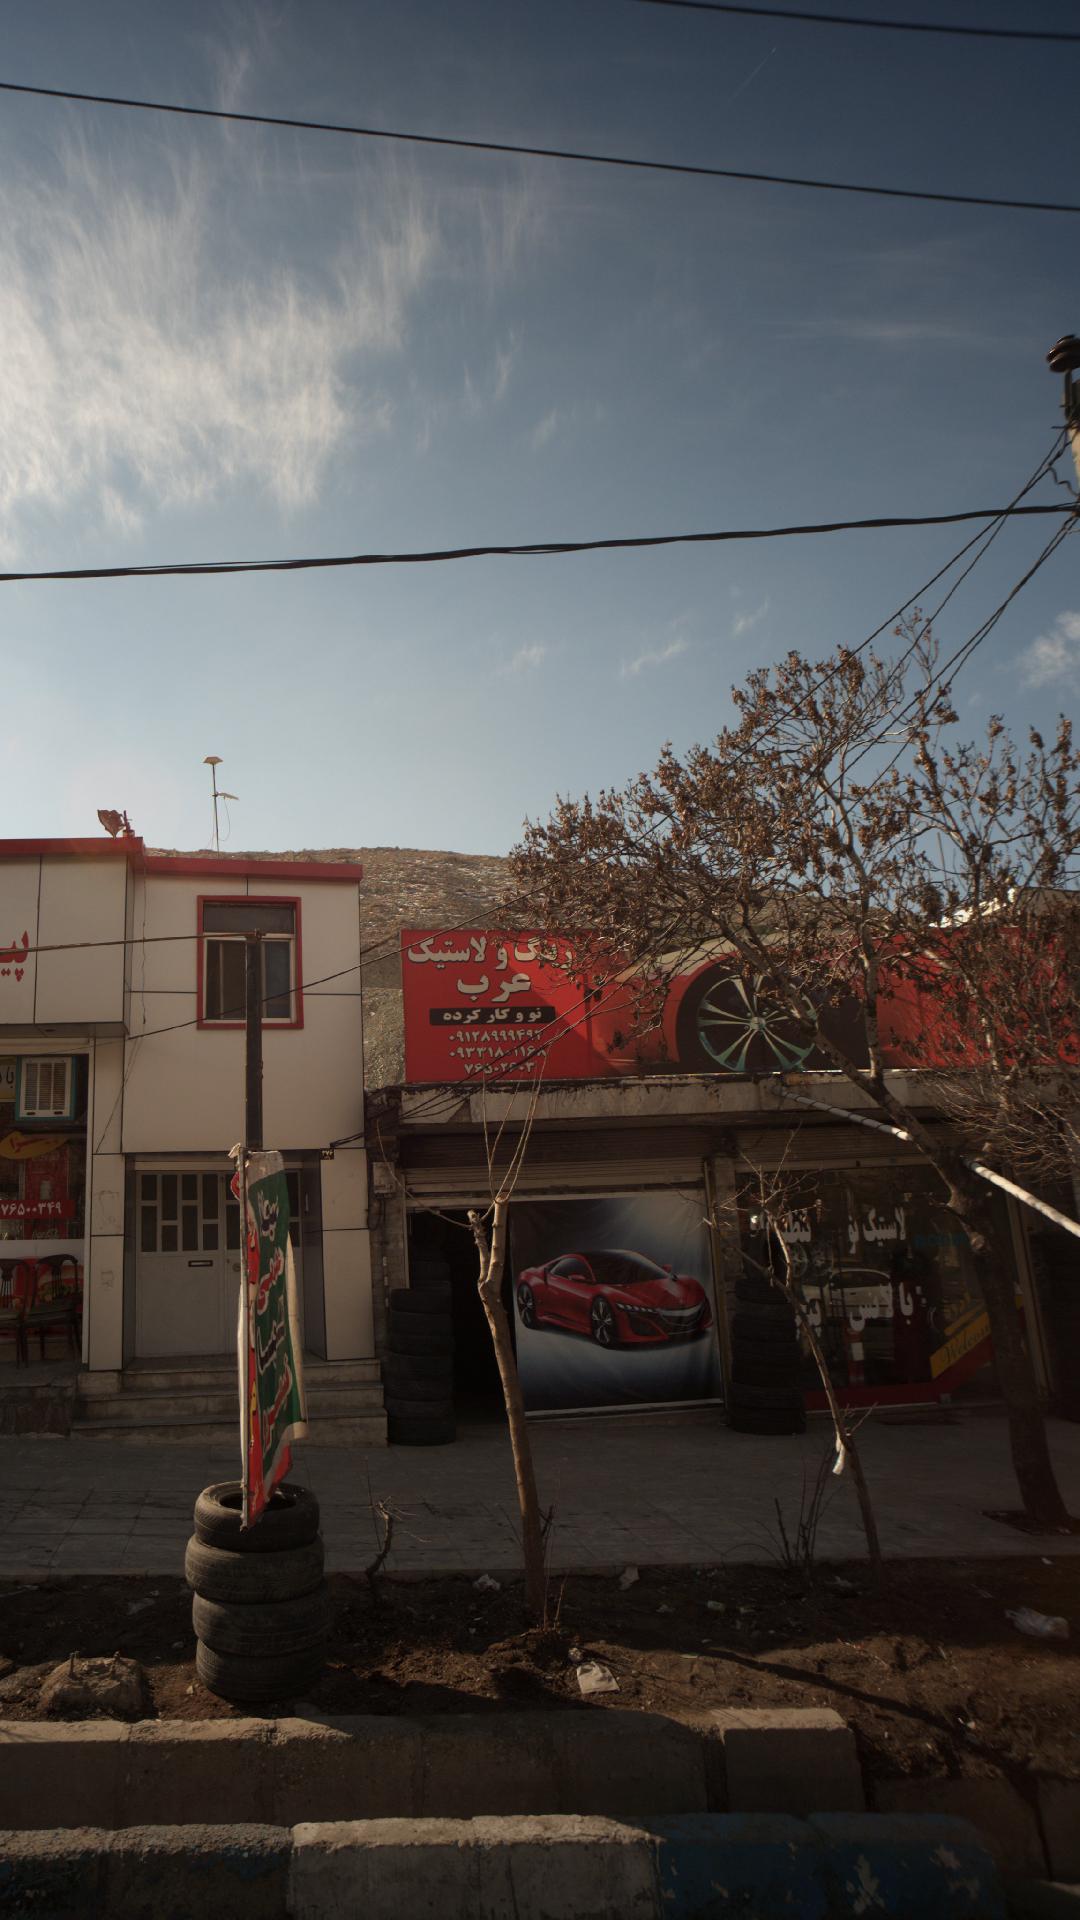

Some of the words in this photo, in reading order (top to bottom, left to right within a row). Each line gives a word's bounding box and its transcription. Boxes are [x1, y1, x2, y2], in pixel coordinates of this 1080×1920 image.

[407, 936, 488, 969] لاستیک
[495, 943, 508, 970] و
[457, 973, 532, 1002] عرب
[443, 1008, 481, 1024] کرده
[486, 1008, 510, 1024] کار
[515, 1010, 524, 1023] و
[529, 1007, 542, 1023] نو
